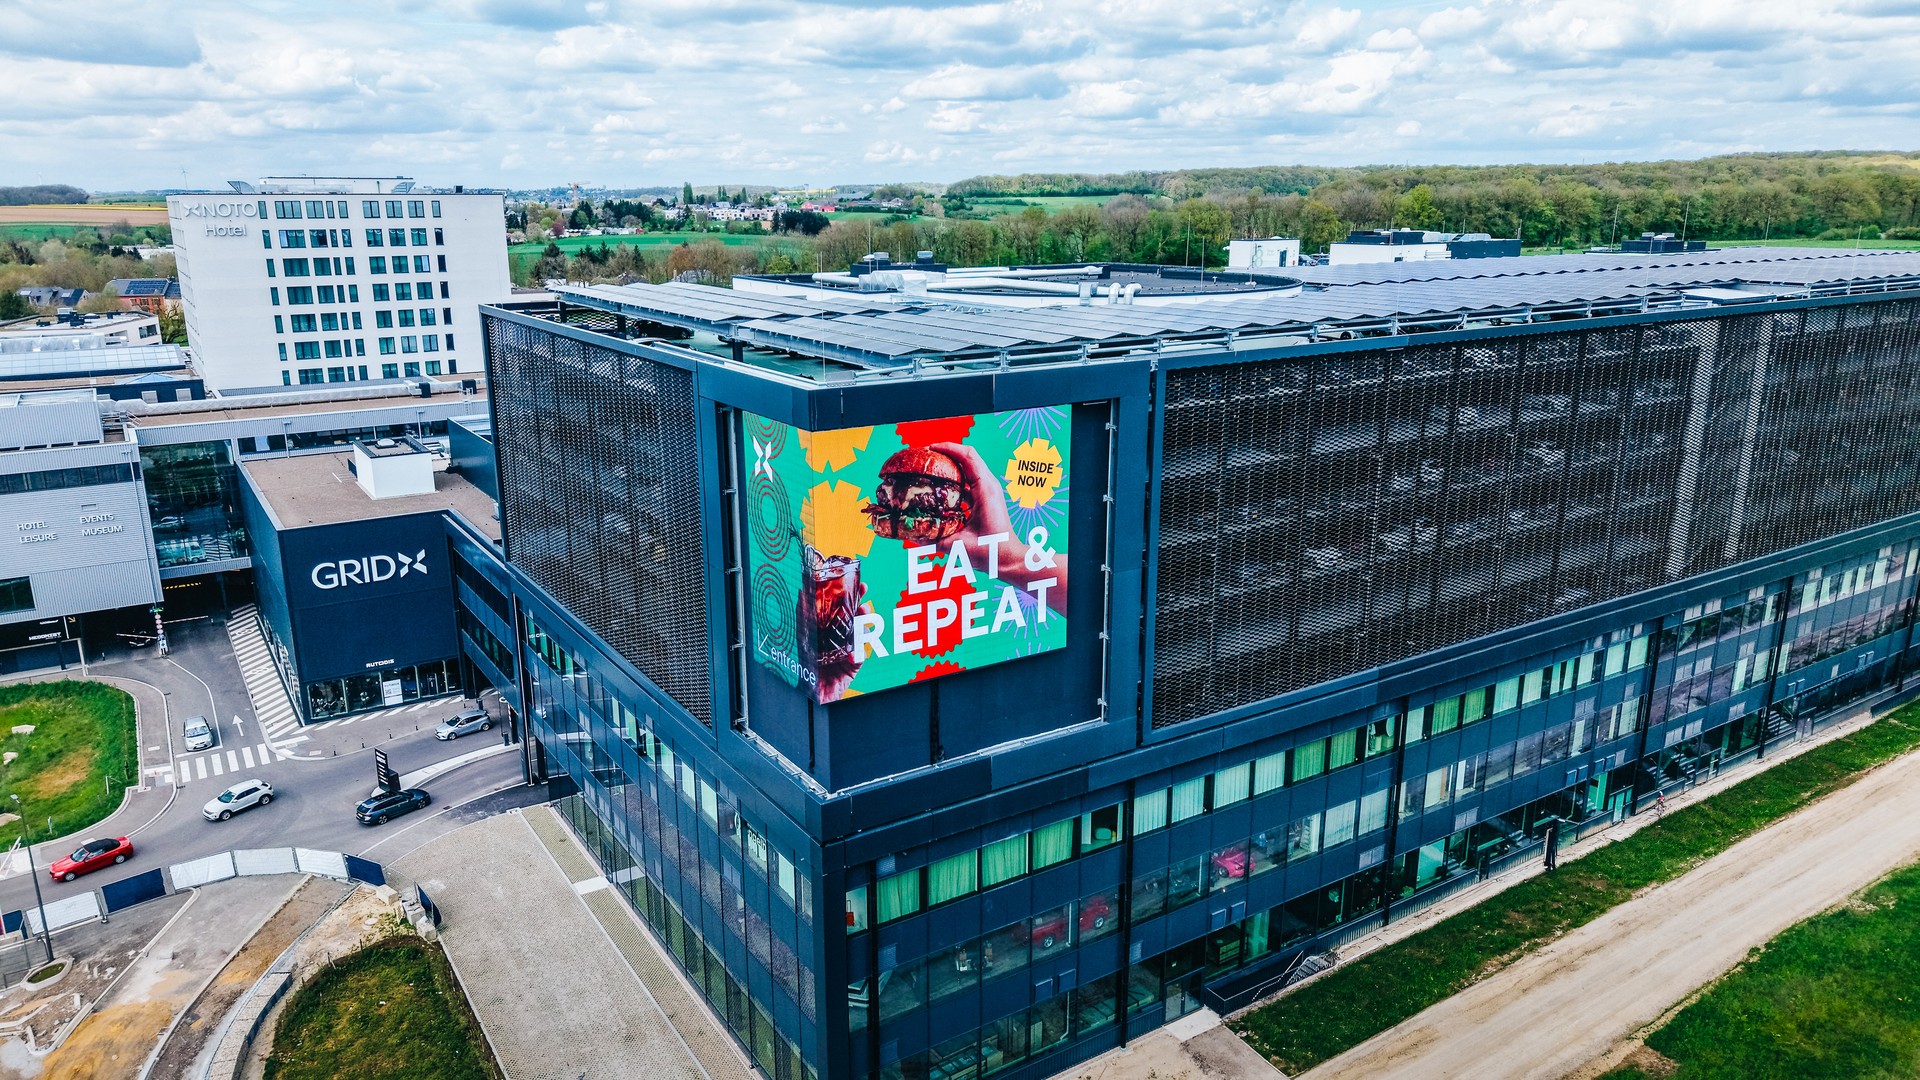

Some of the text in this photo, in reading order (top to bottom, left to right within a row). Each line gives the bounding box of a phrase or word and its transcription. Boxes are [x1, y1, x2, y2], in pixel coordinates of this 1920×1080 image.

[205, 224, 247, 237] Hotel
[1018, 459, 1054, 474] INSIDE
[1017, 475, 1047, 488] NOW
[80, 514, 114, 524] EVENTS
[17, 521, 49, 532] HOTEL
[81, 525, 124, 537] MUSEUM
[19, 533, 58, 544] LEISURE
[908, 525, 1057, 595] EAT &
[853, 577, 1058, 664] REPEAT
[771, 647, 816, 686] entrance
